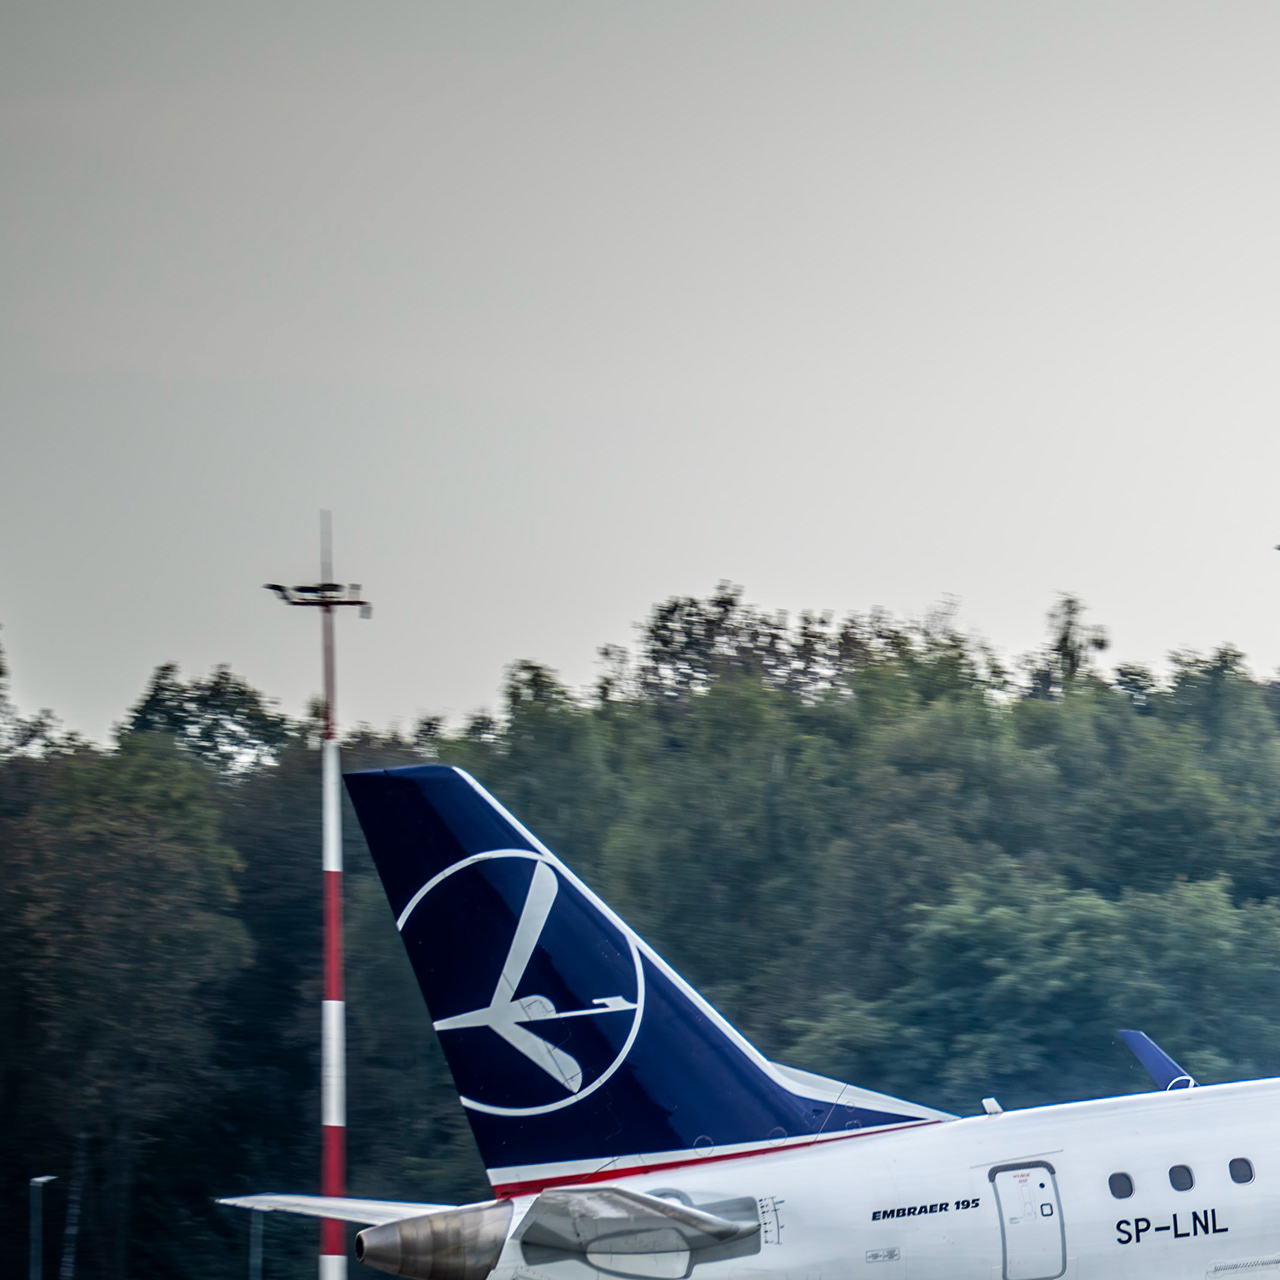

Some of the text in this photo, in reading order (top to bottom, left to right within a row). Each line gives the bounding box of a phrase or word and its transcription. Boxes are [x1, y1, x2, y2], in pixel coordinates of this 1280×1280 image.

[871, 1198, 981, 1221] EMBRAER 195
[1115, 1208, 1229, 1245] SP-LNL
